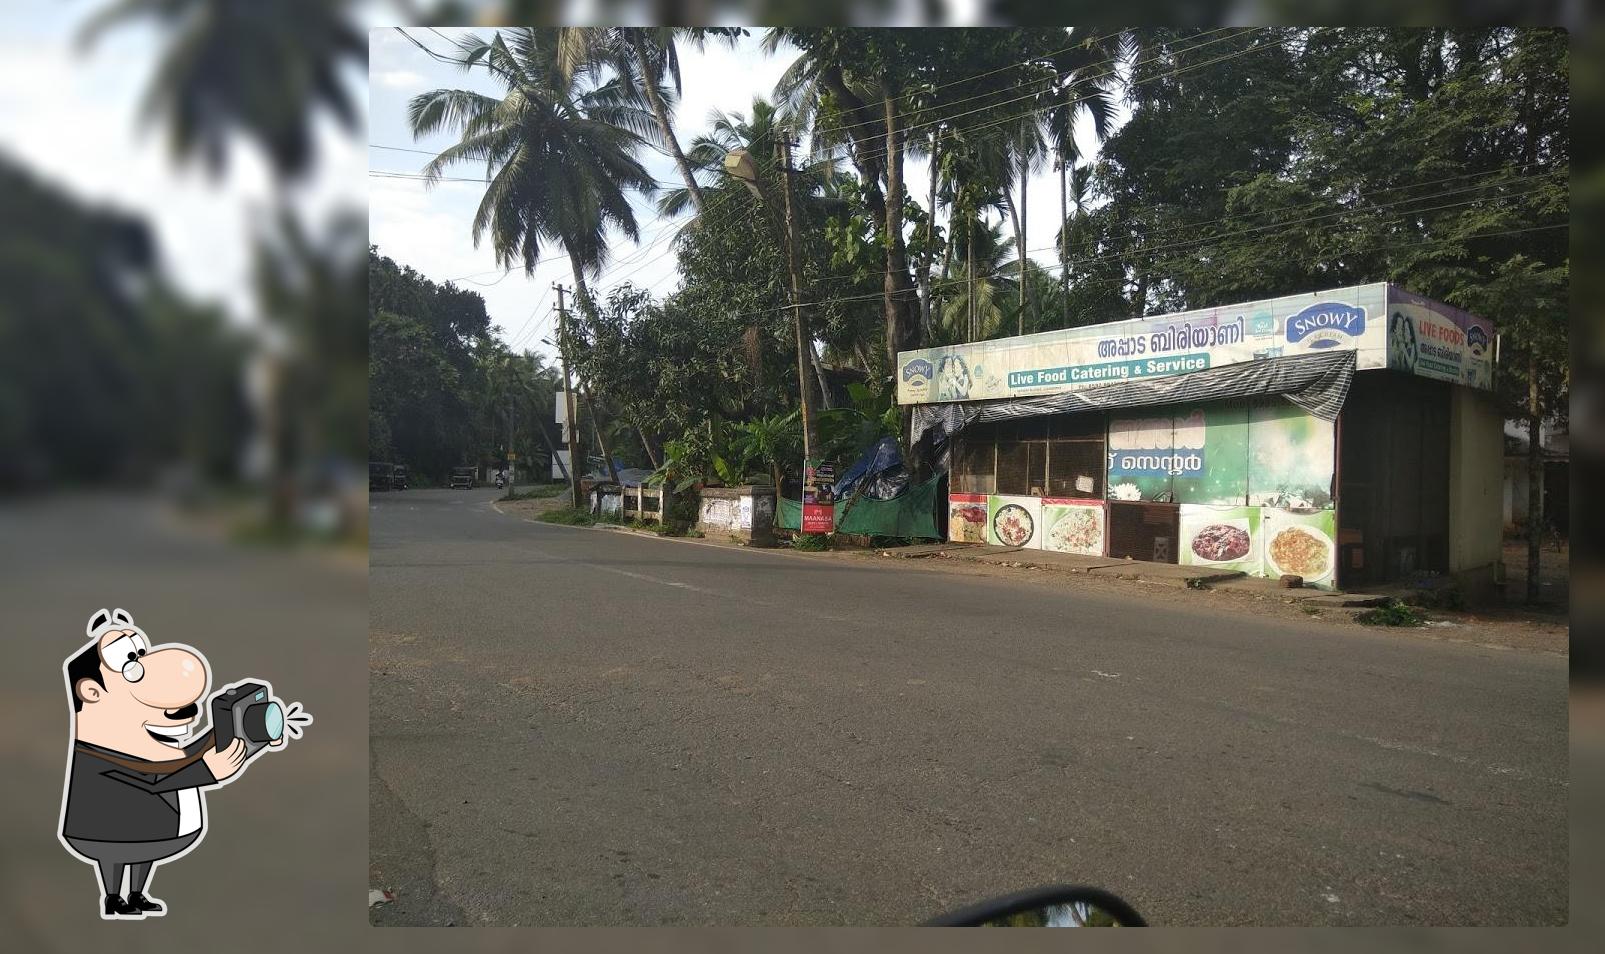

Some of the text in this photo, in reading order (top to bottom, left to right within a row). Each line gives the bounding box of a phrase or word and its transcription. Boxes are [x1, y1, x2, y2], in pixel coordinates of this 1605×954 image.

[1150, 315, 1245, 353] ബിരിയാണി
[1295, 311, 1358, 335] SNOWY
[1419, 320, 1437, 338] LIVE
[905, 364, 931, 377] SNOWY
[1011, 356, 1206, 385] Live Food Catering & Service
